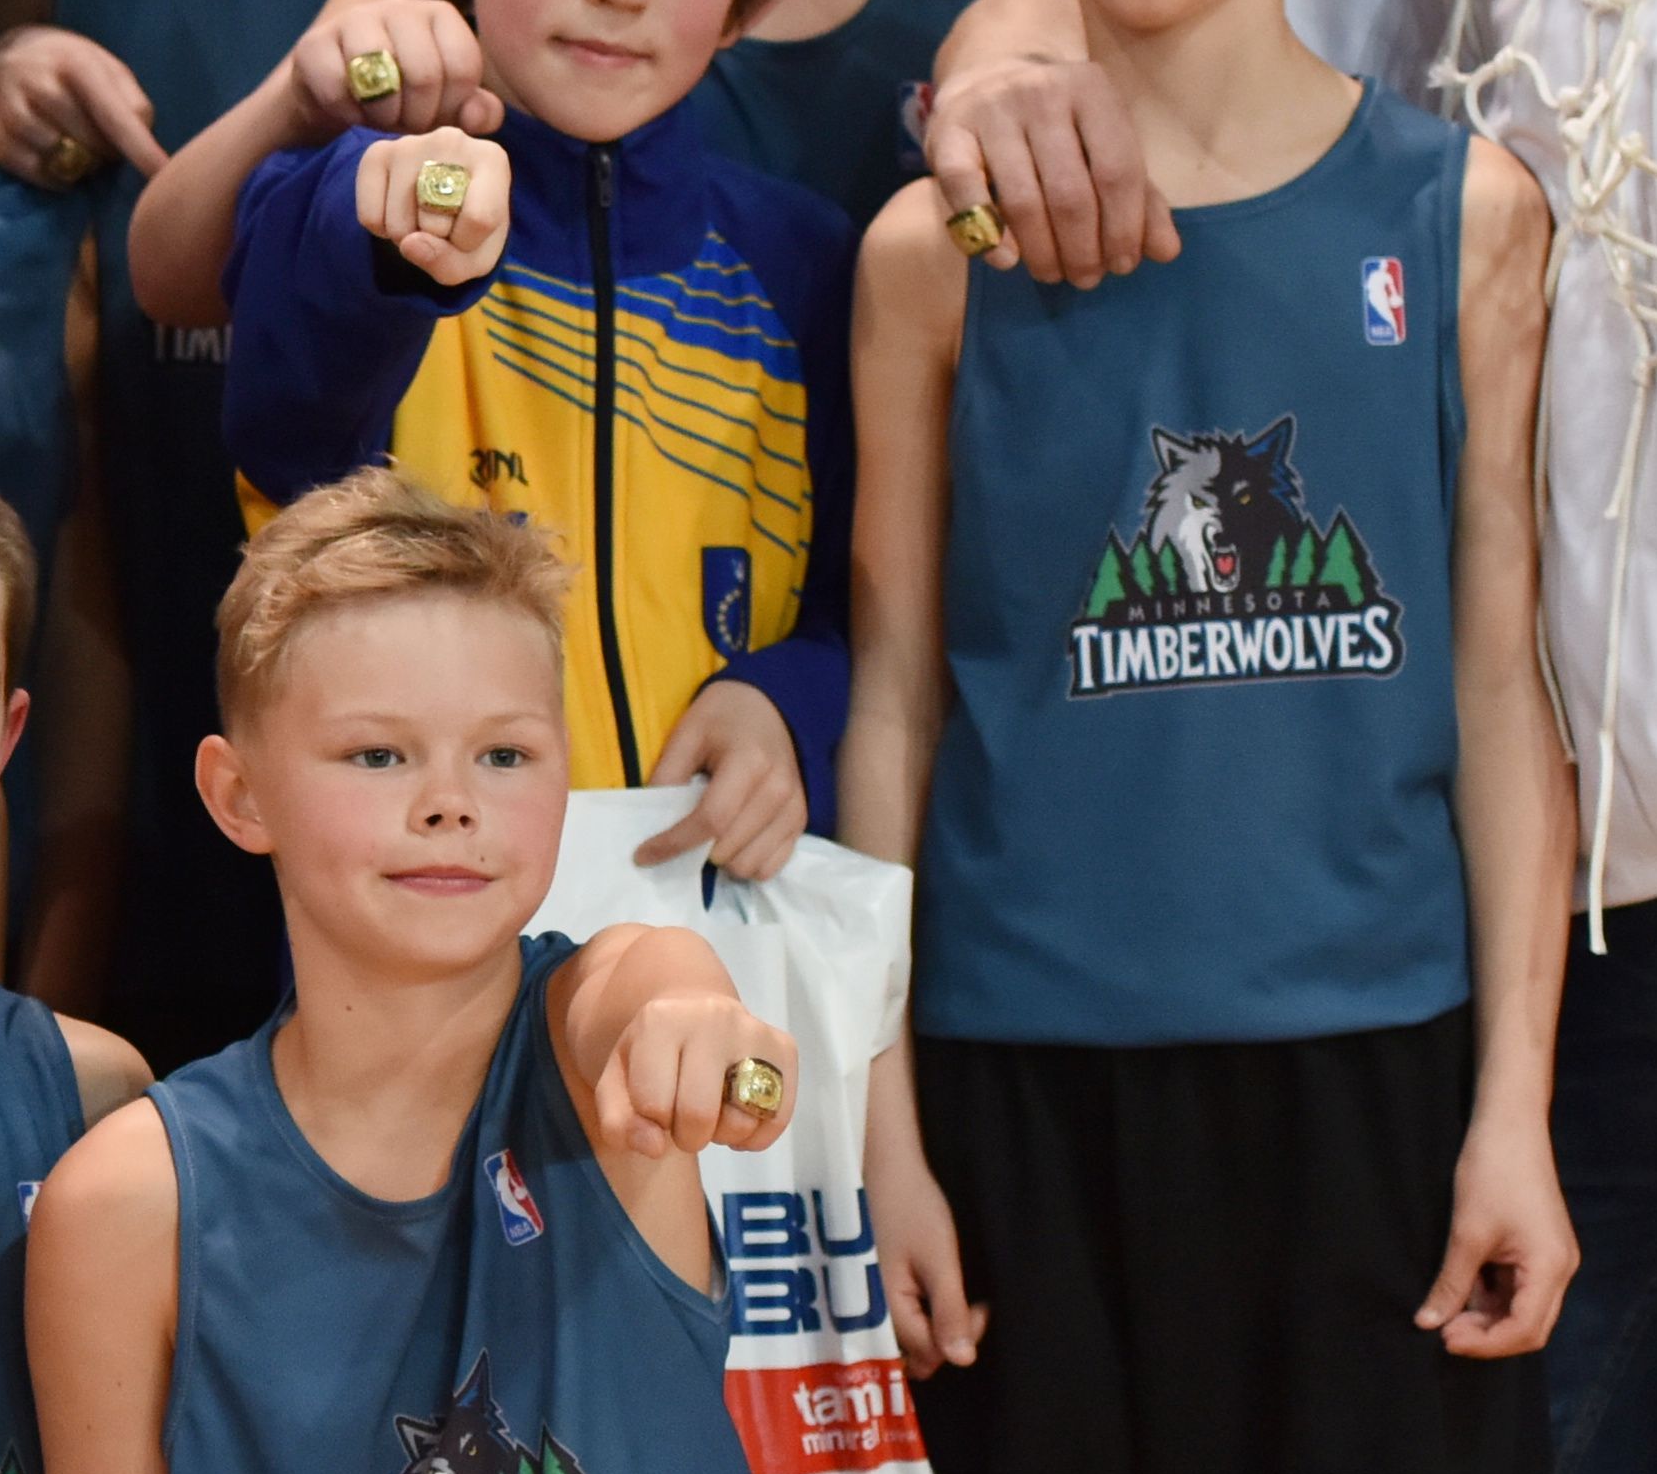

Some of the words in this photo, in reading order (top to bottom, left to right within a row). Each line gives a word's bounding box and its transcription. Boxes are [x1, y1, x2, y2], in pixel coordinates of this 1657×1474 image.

[1128, 590, 1331, 622] MINNESOTA
[1072, 606, 1394, 689] TIMBERWOLVES
[722, 1188, 877, 1258] BRU
[729, 1263, 889, 1336] BRU
